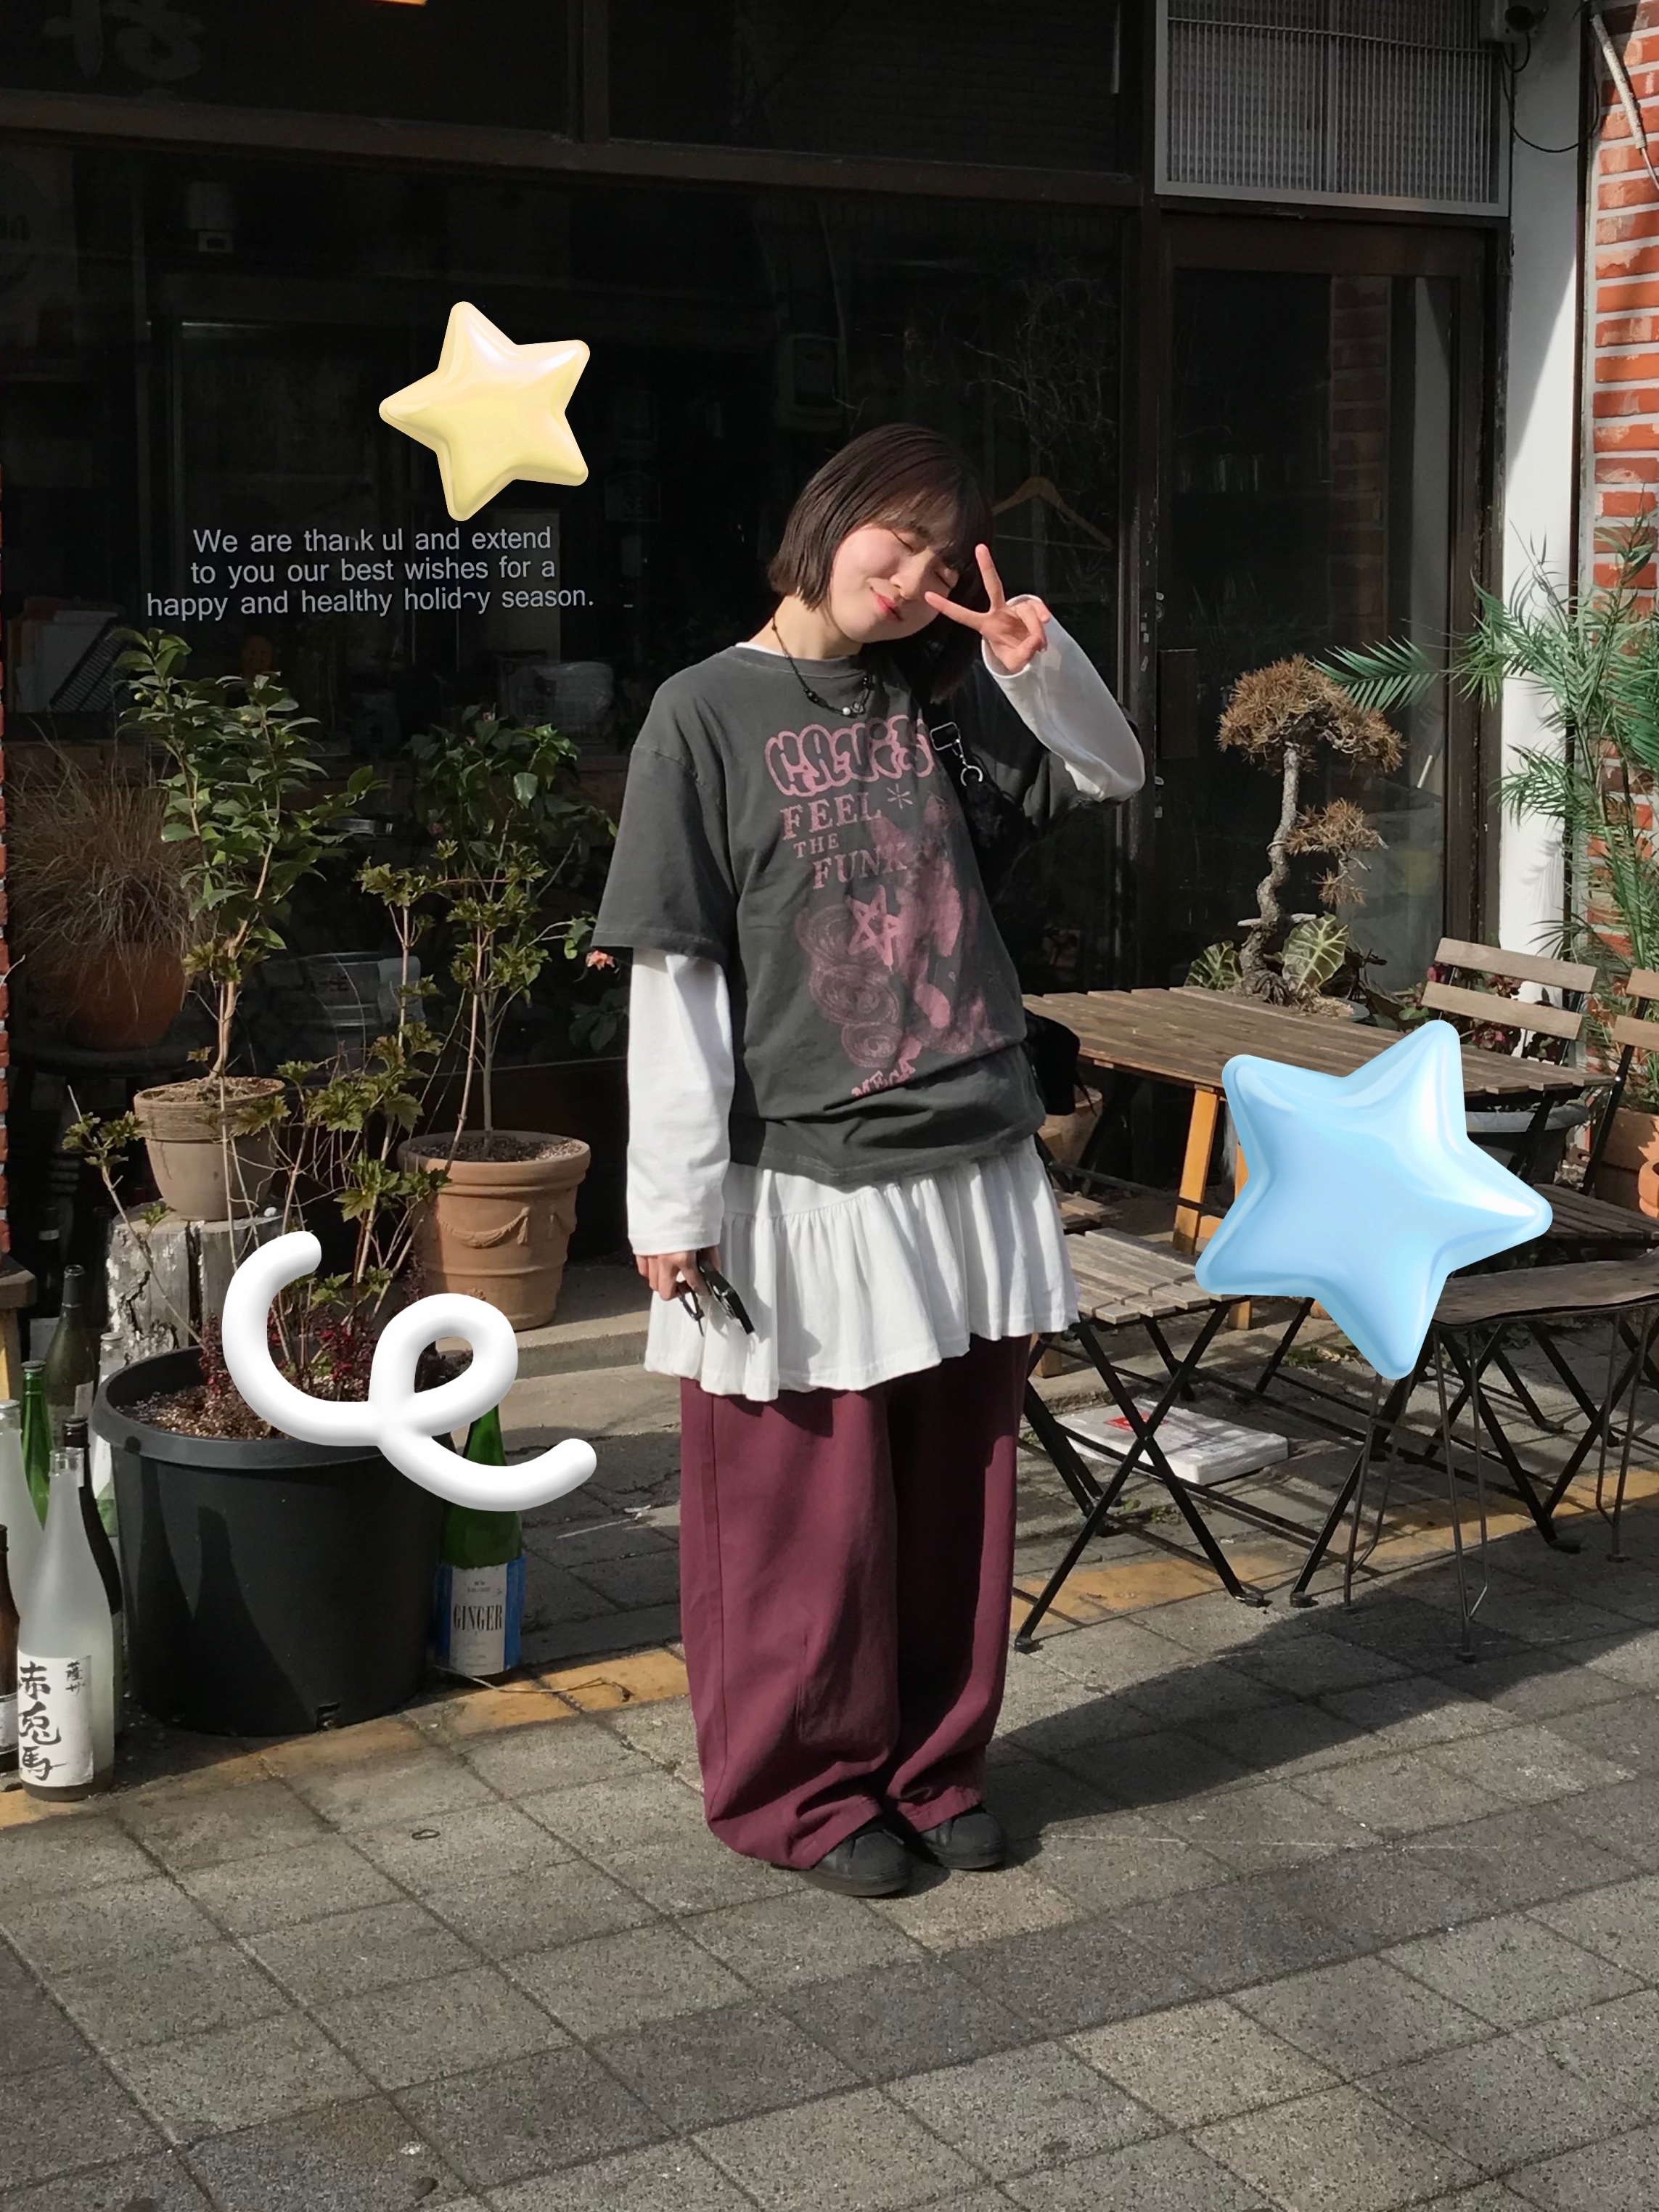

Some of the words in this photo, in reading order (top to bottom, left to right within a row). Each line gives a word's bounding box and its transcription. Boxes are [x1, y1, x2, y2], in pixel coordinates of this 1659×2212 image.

[192, 529, 238, 553] We
[250, 534, 292, 552] are
[303, 528, 403, 552] thankul
[415, 528, 459, 551] and
[472, 526, 551, 549] extend
[191, 562, 216, 584] to
[228, 565, 274, 589] you
[287, 564, 330, 582] our
[340, 558, 395, 581] best
[404, 557, 488, 580] wishes
[499, 555, 532, 578] for
[541, 560, 555, 578] a
[147, 592, 229, 622] happy
[240, 589, 288, 615] and
[301, 588, 393, 617] healthy
[501, 589, 594, 608] season.
[780, 792, 882, 840] FEEL
[793, 833, 839, 859] THE
[453, 1604, 503, 1631] GINGER
